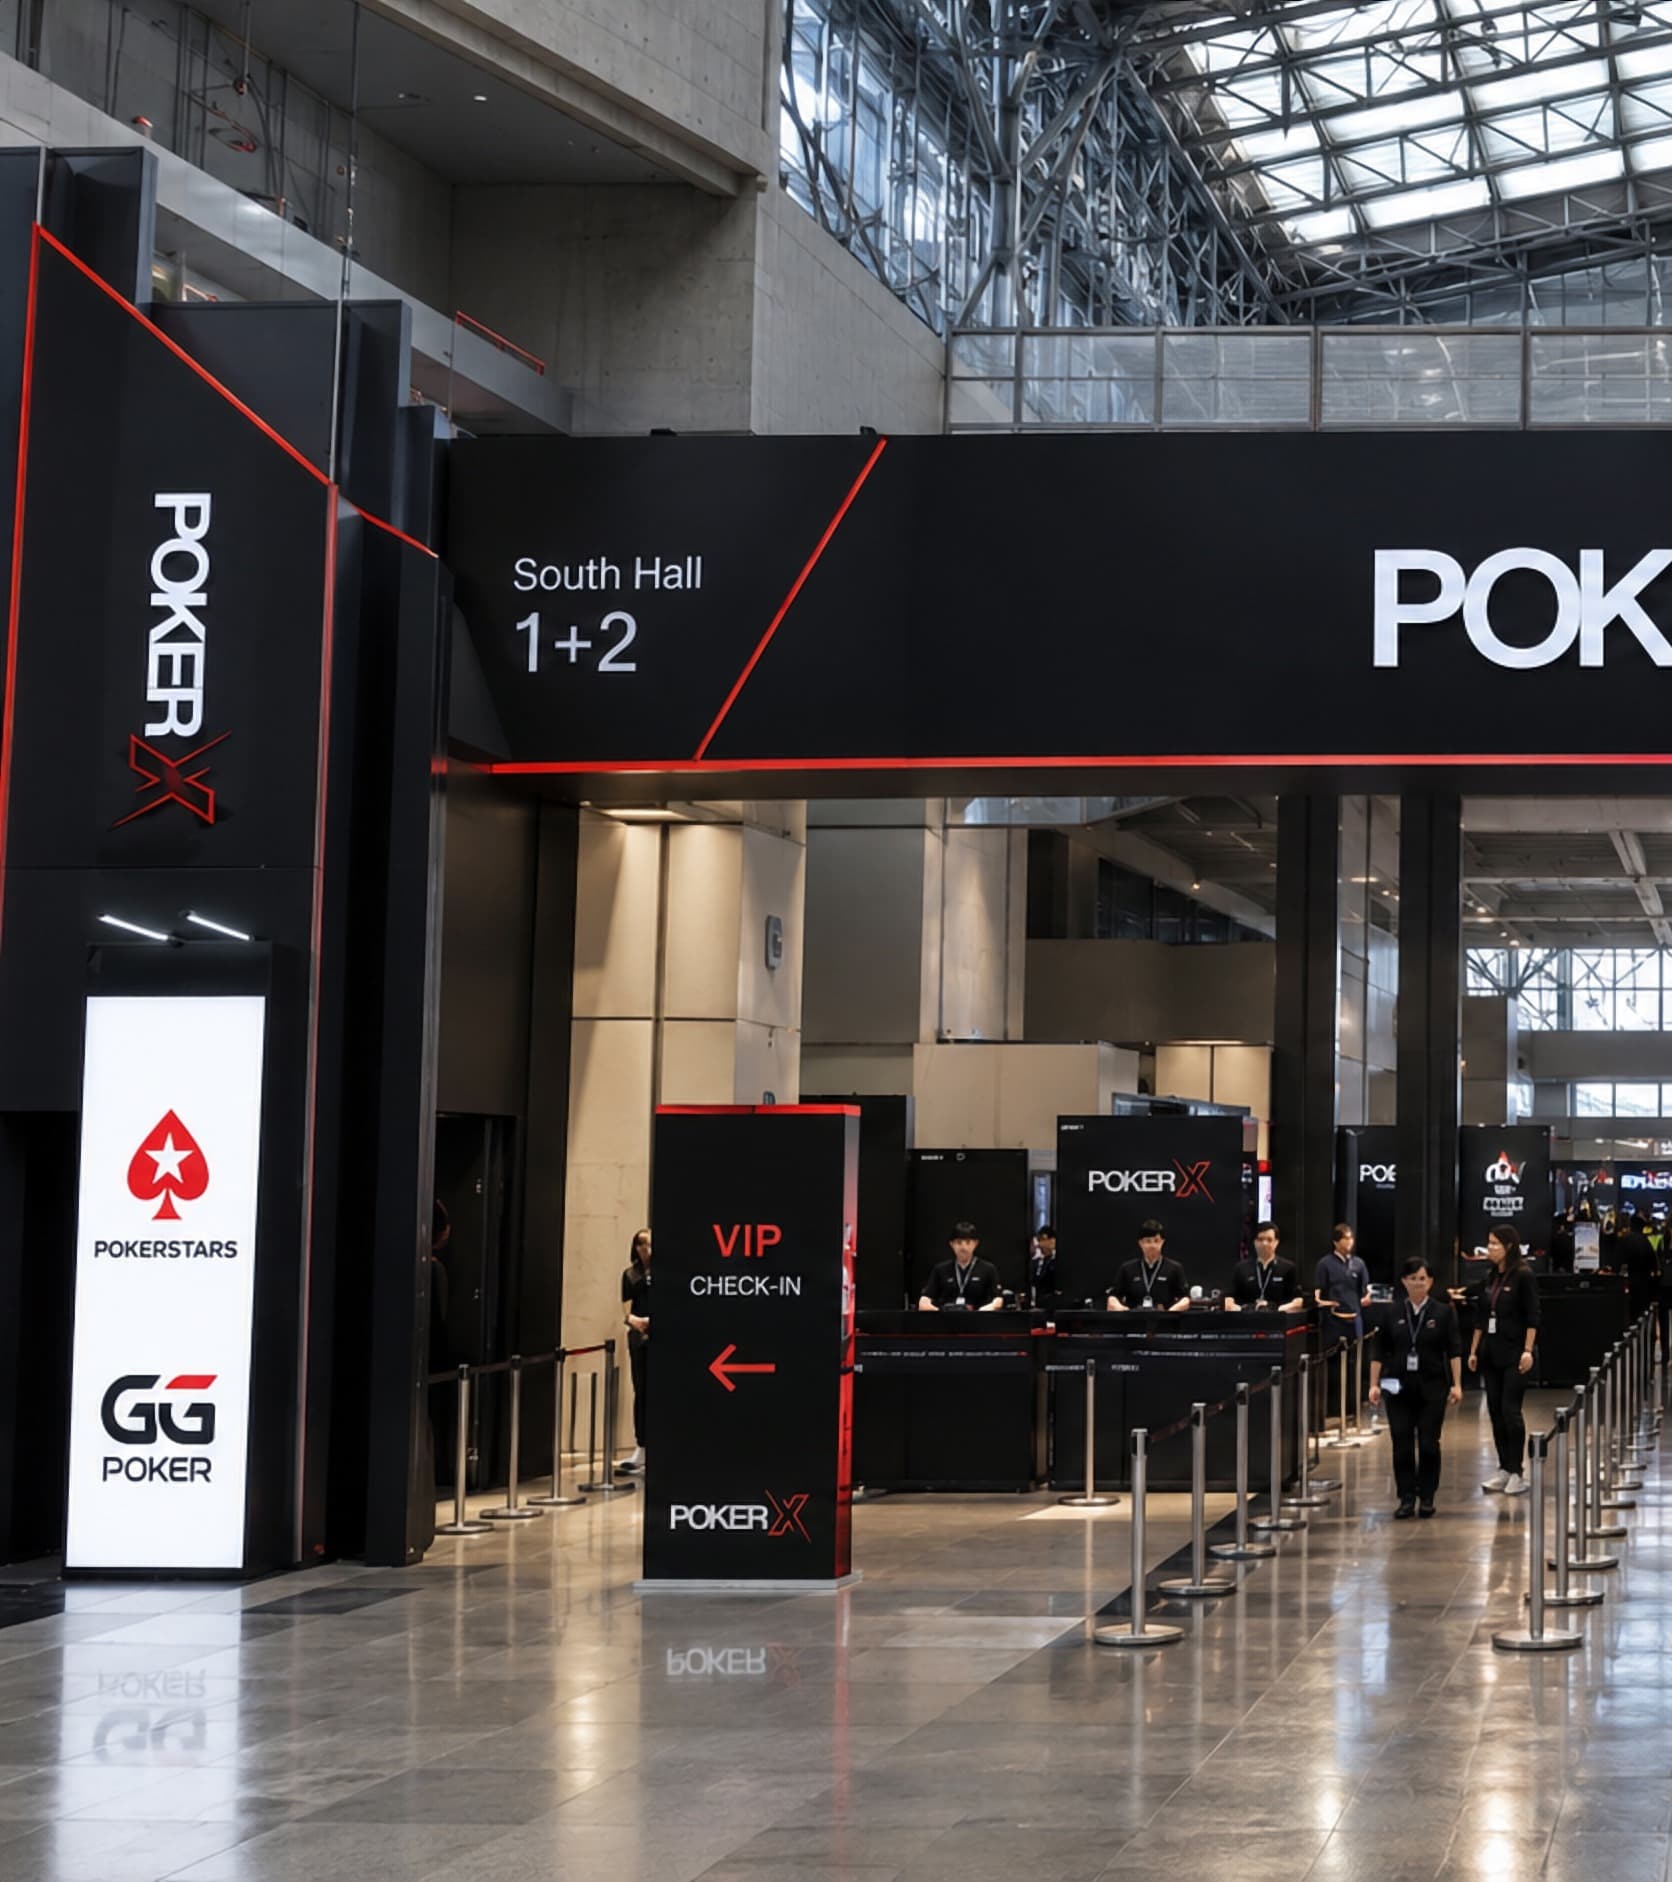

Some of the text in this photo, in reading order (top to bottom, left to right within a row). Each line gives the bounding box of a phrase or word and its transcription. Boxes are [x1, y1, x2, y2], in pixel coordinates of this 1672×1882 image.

[513, 555, 702, 591] South Hall
[516, 611, 637, 673] 1+2
[94, 1240, 238, 1259] POKERSTARS
[712, 1223, 783, 1258] VIP
[690, 1275, 801, 1296] CHECK-IN
[101, 1374, 218, 1445] GG
[102, 1456, 212, 1483] POKER
